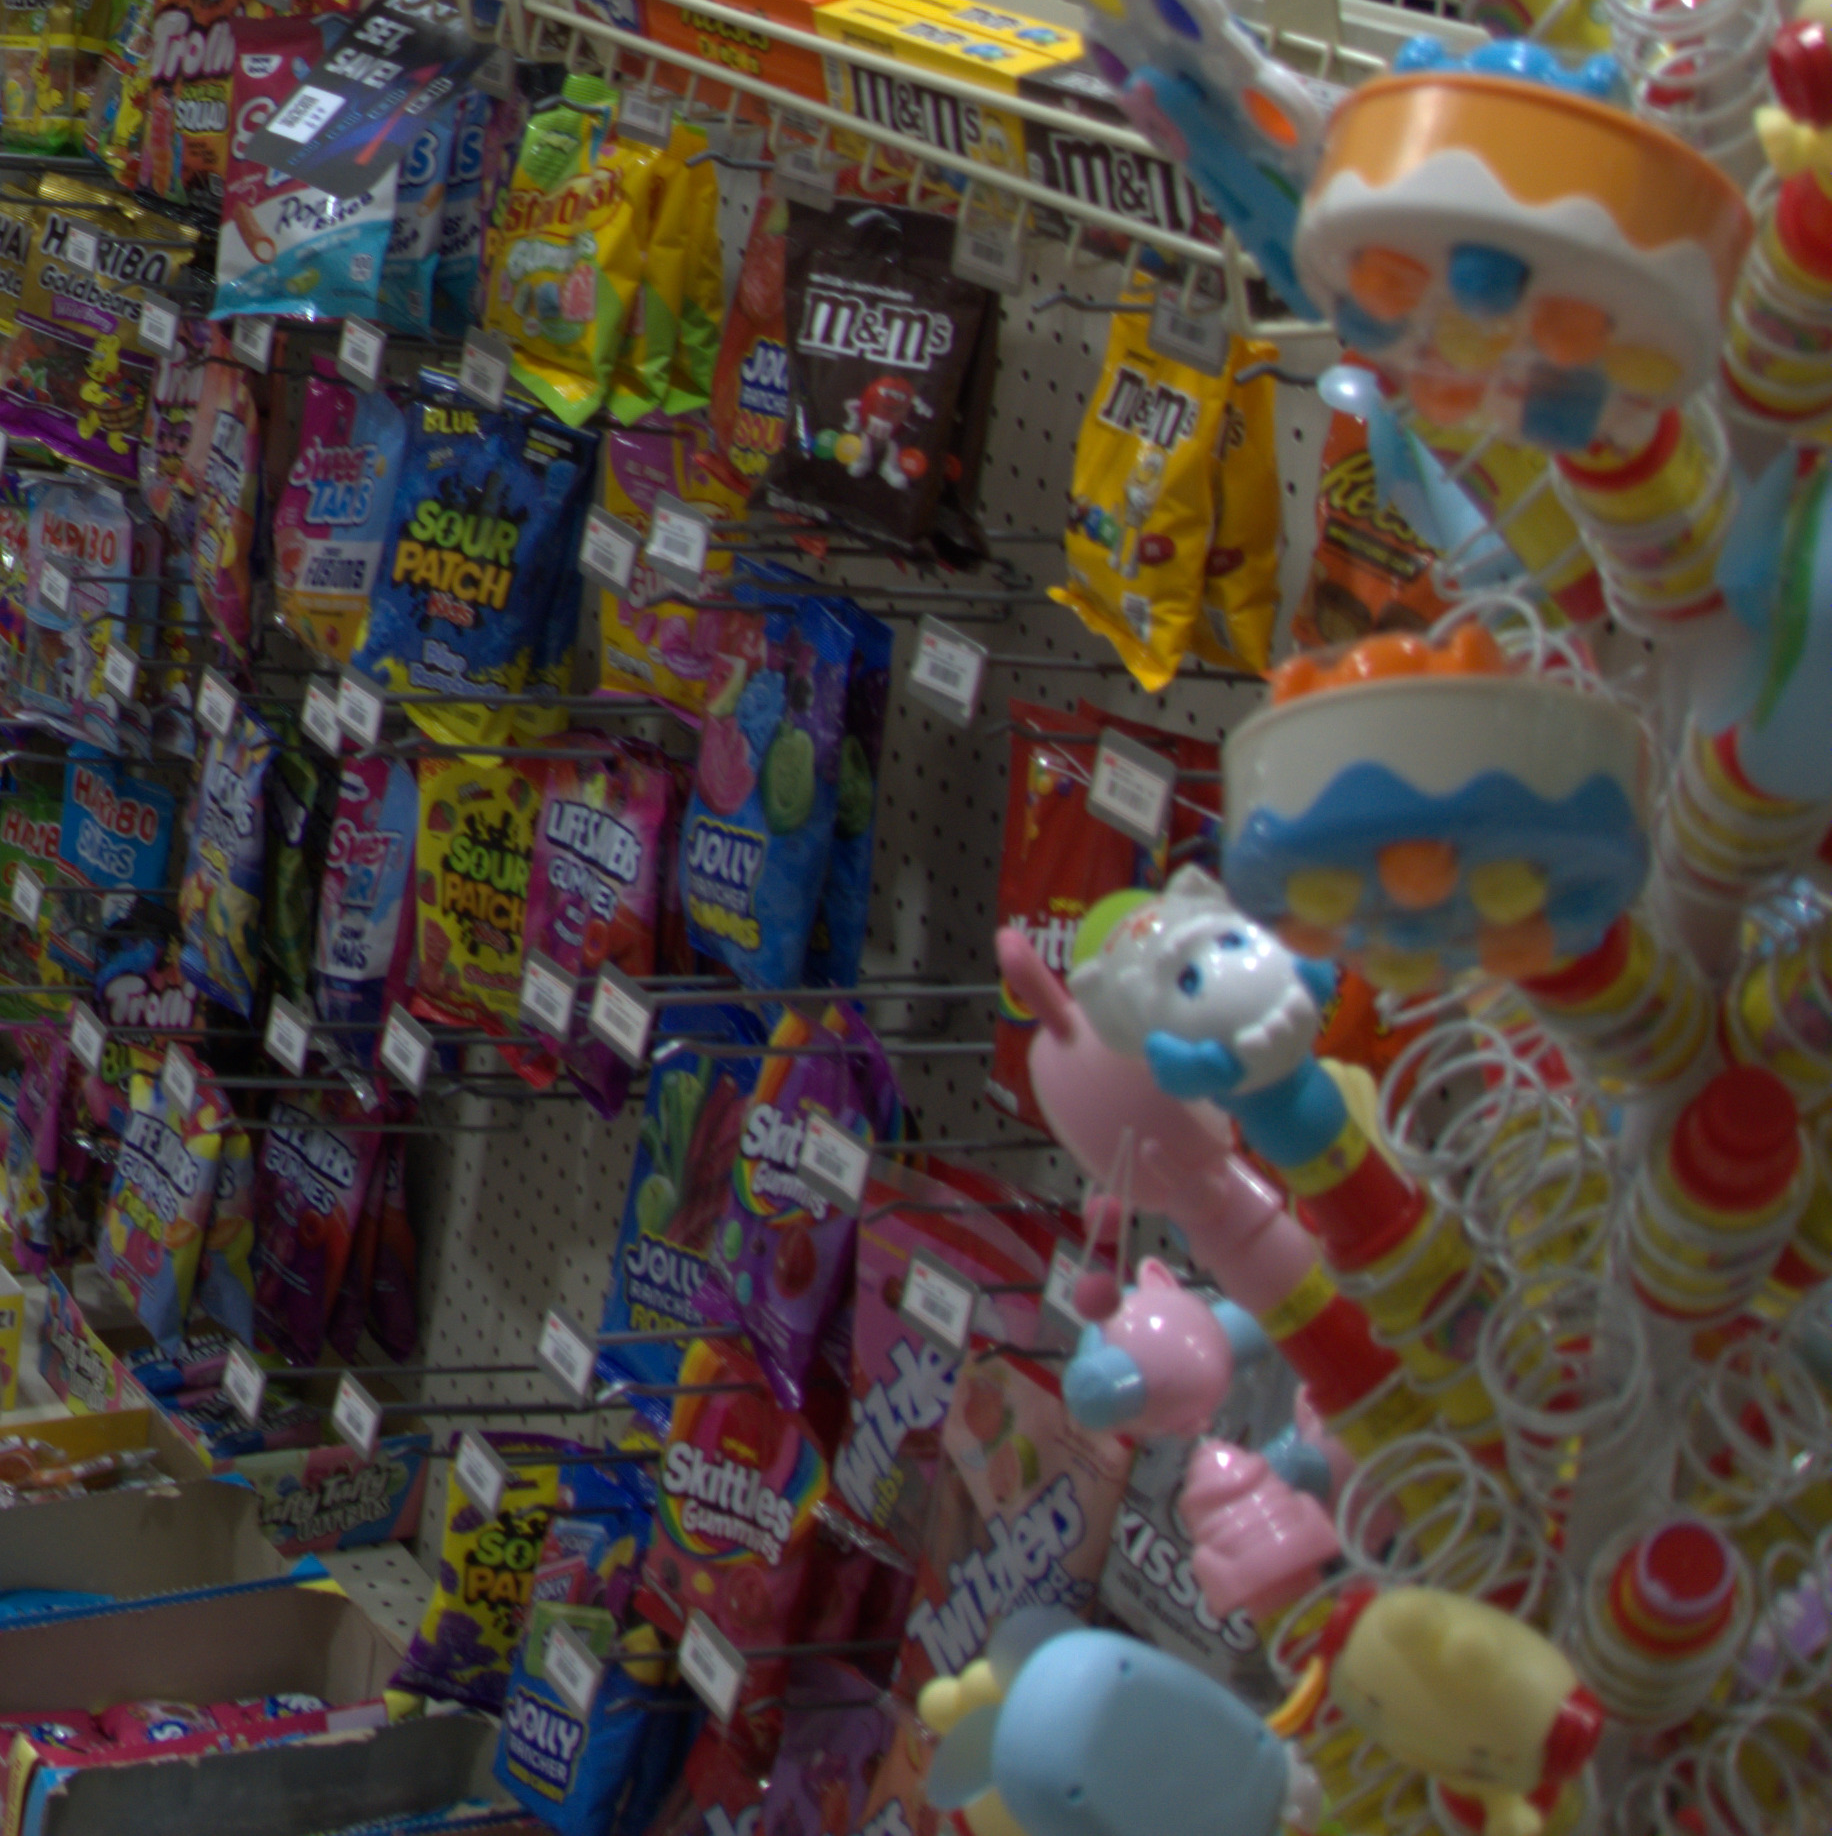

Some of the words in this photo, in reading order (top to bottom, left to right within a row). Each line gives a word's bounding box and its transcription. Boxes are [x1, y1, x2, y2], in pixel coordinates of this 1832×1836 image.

[43, 218, 169, 284] HRIBO
[39, 268, 142, 321] Goldbears
[422, 407, 479, 434] BLUE
[409, 500, 520, 563] SOUR
[394, 542, 512, 609] PATCH
[448, 834, 529, 894] SOUR
[687, 825, 761, 885] JOLLY
[443, 877, 526, 927] PATCH
[104, 985, 196, 1027] Trolli
[661, 1442, 794, 1542] Skittles
[506, 1693, 582, 1766] JOLLY
